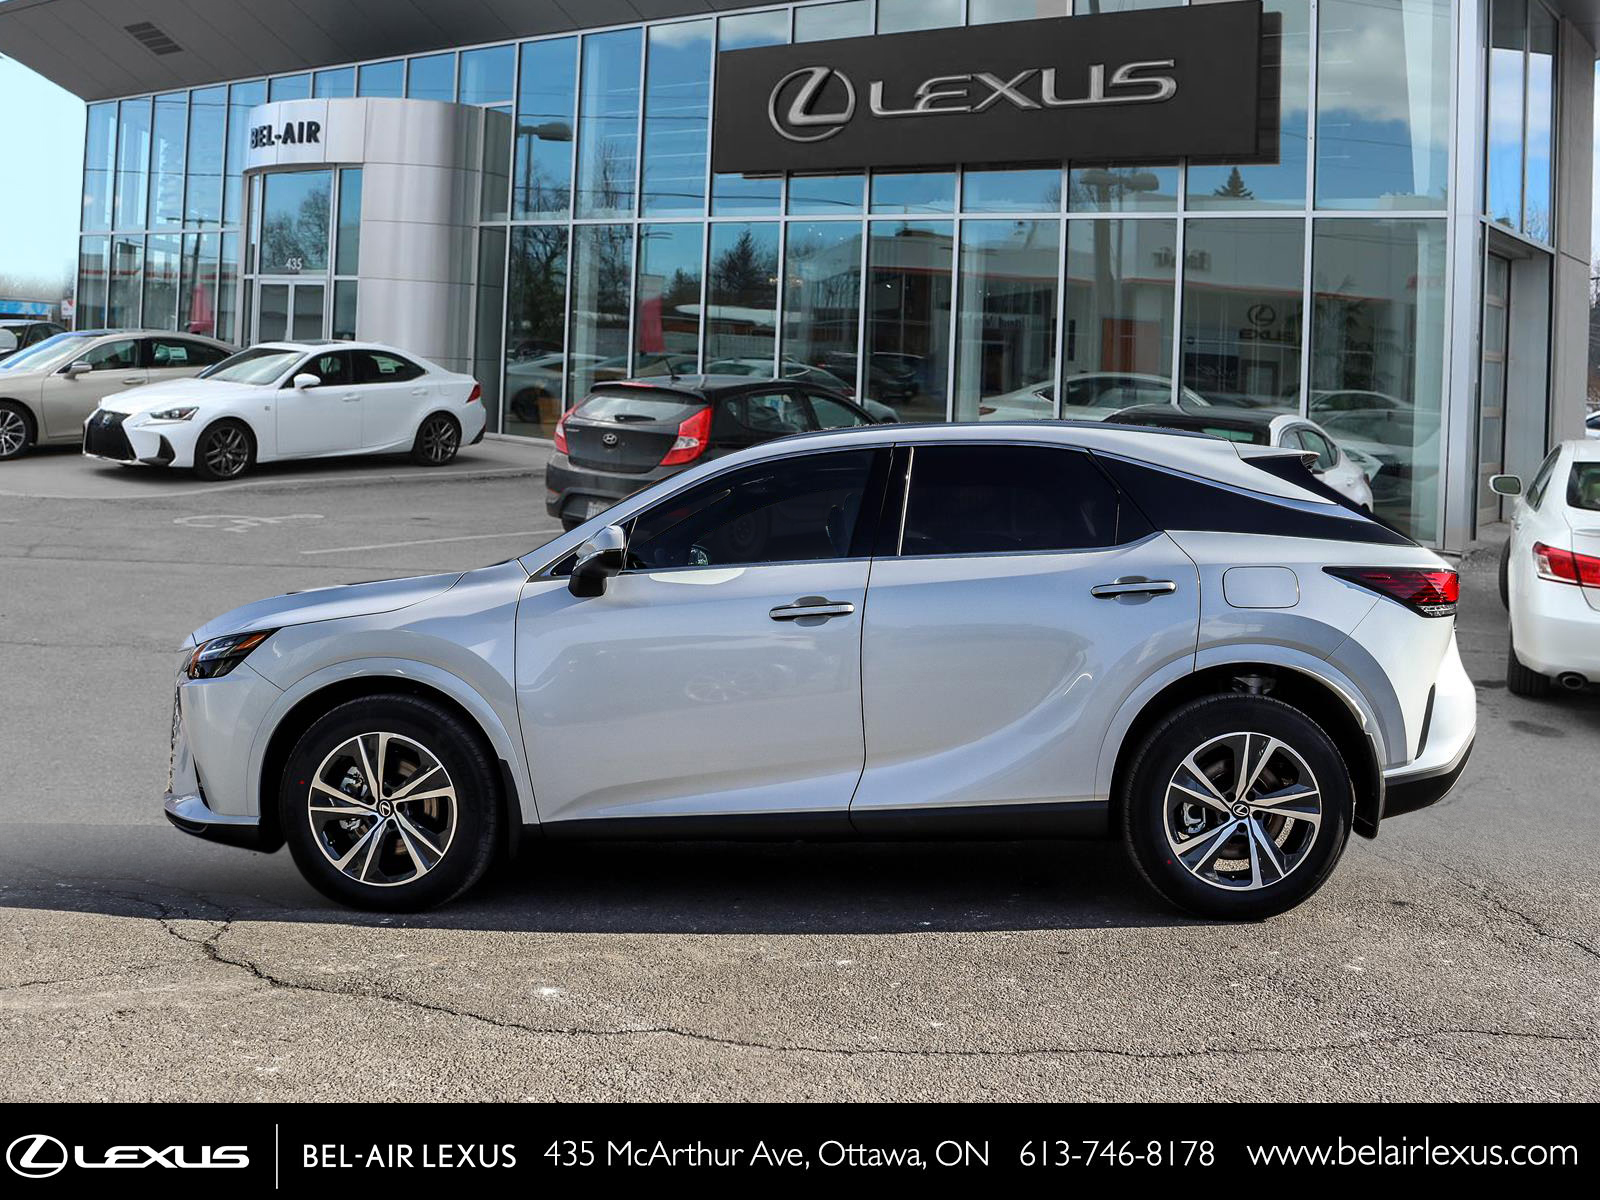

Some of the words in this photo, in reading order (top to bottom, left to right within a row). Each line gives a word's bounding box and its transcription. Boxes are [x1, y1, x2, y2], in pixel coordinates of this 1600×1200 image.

[869, 58, 1178, 118] LEXUS
[250, 120, 321, 149] BEL-AIR
[285, 257, 303, 270] 435
